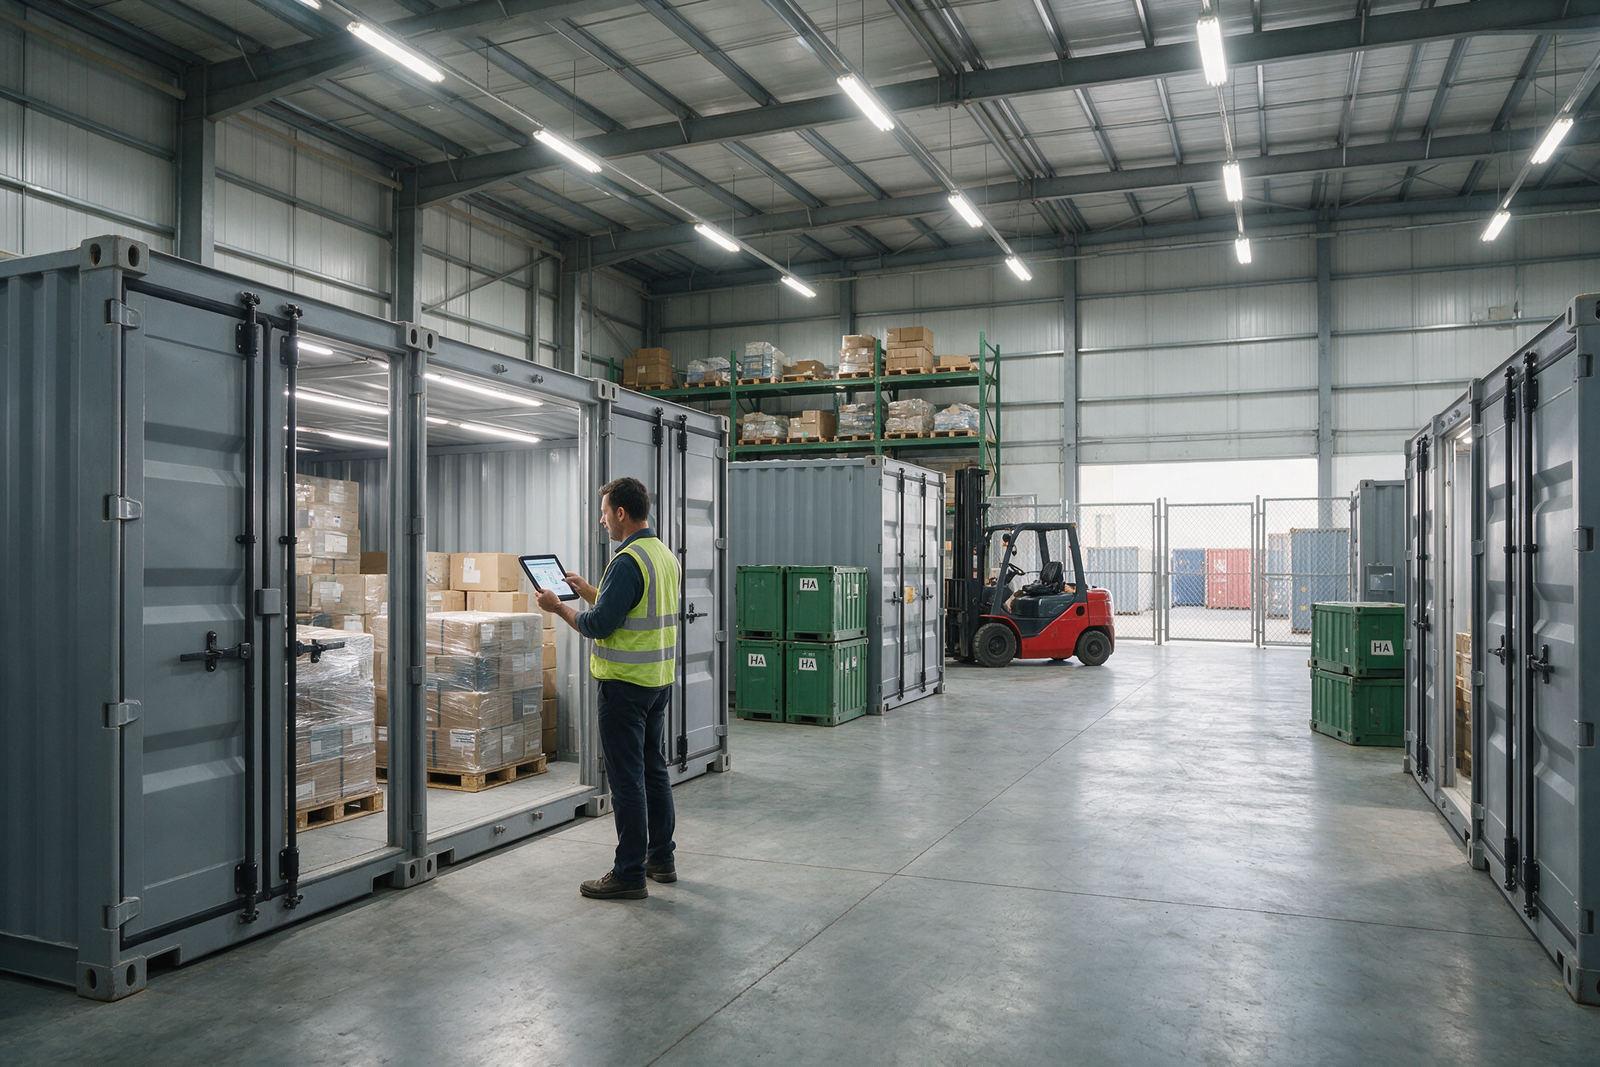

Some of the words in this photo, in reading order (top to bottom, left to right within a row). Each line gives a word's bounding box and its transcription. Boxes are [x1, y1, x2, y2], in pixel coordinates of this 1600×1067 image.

[802, 579, 817, 589] HA
[1374, 642, 1391, 653] HA
[750, 655, 764, 665] HA
[801, 659, 815, 669] HA
